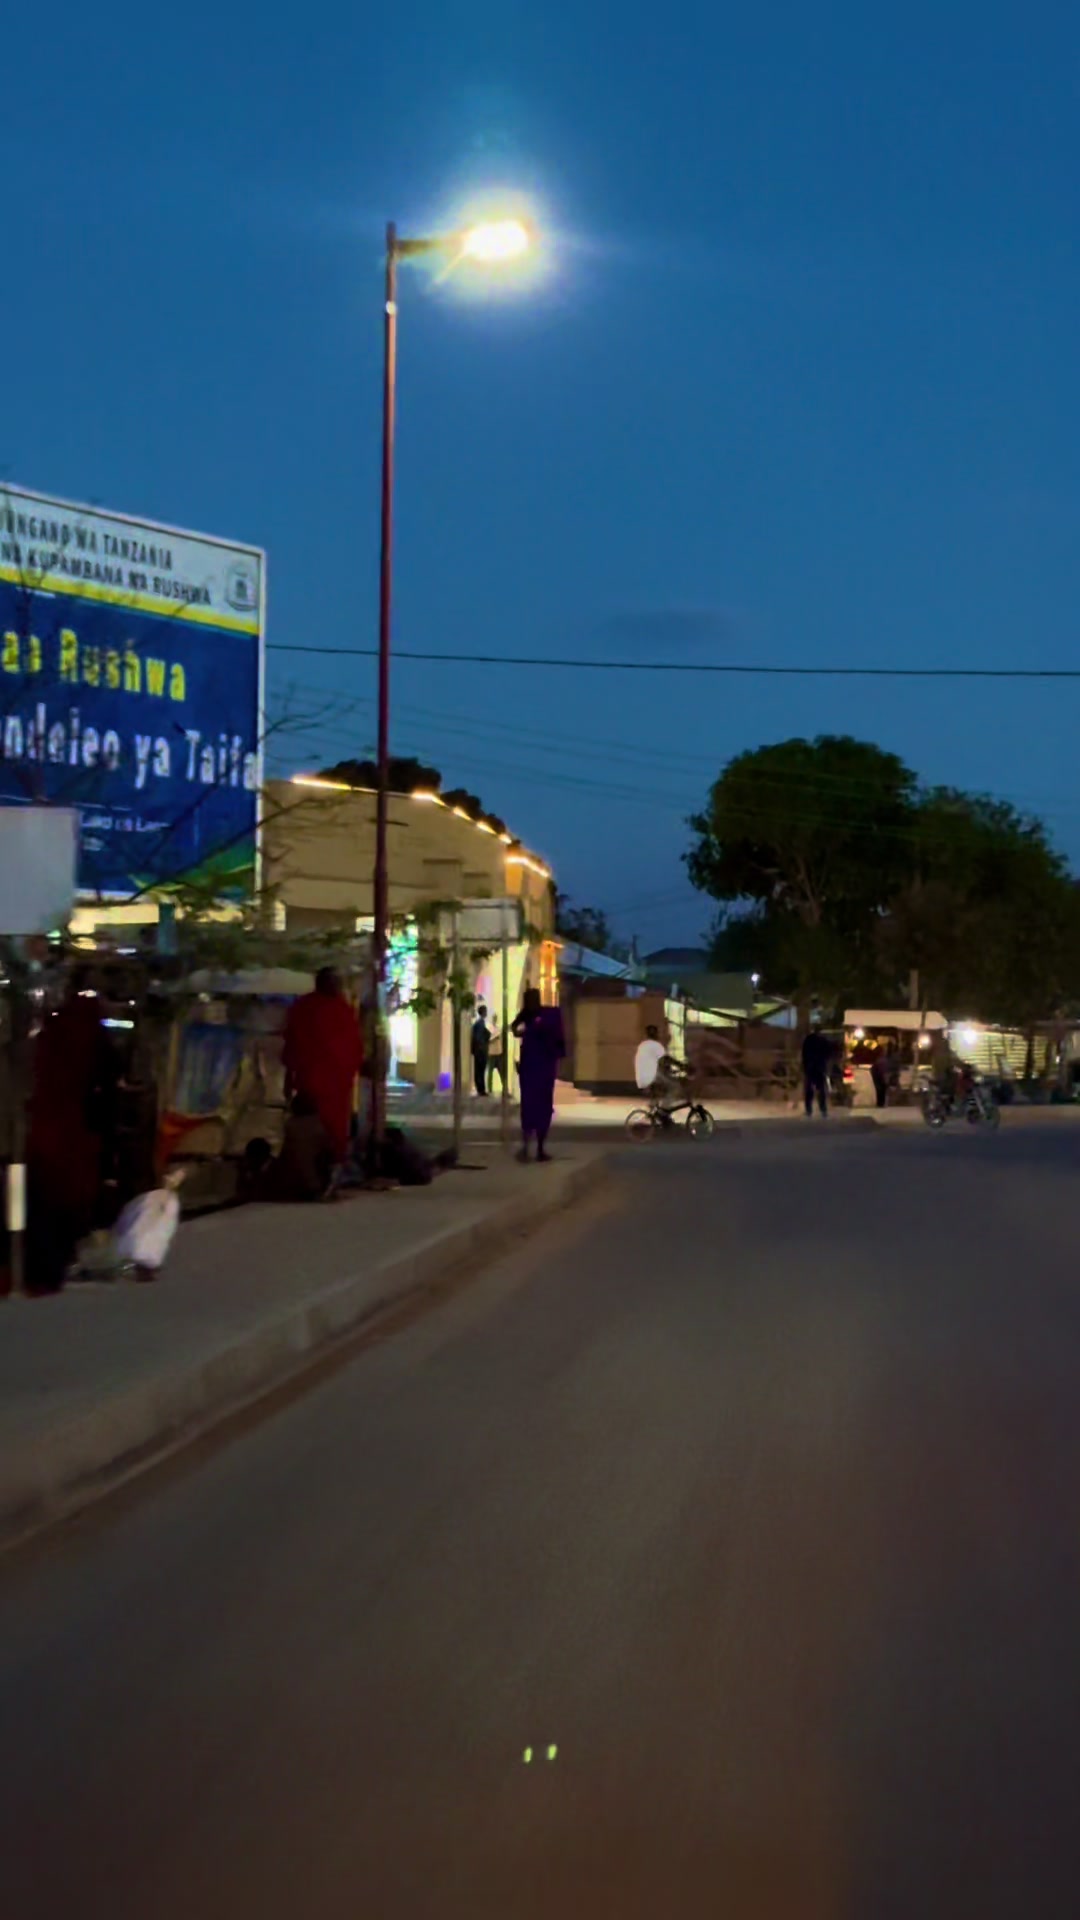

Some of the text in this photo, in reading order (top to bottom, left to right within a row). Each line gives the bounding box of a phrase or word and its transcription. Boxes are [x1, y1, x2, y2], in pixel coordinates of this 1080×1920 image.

[28, 548, 123, 585] KUPAMBANA
[152, 576, 212, 605] RUSHWA
[103, 534, 172, 570] TANZANIA
[59, 628, 187, 702] Rushwa
[0, 701, 257, 791] ndeleo ya Taifa
